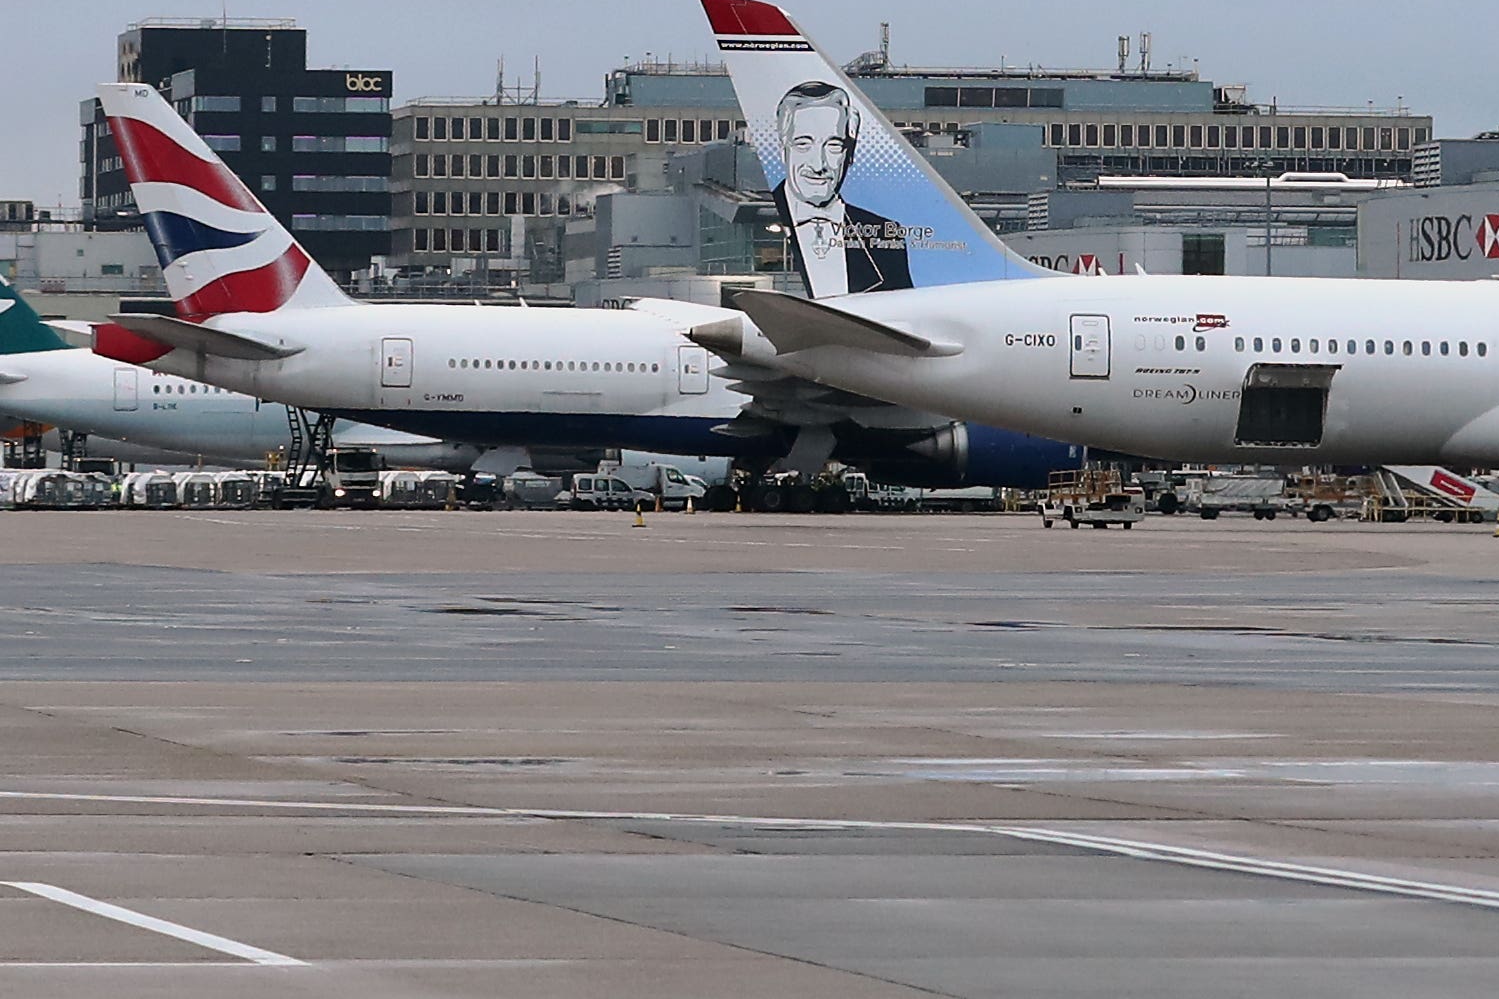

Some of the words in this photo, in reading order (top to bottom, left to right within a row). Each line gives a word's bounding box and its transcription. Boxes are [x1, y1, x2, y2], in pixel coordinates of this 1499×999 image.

[346, 73, 382, 91] bloc
[831, 222, 881, 238] Victor
[884, 222, 934, 241] Borge
[1409, 214, 1472, 262] HSBC
[1005, 334, 1056, 347] G-CIXO
